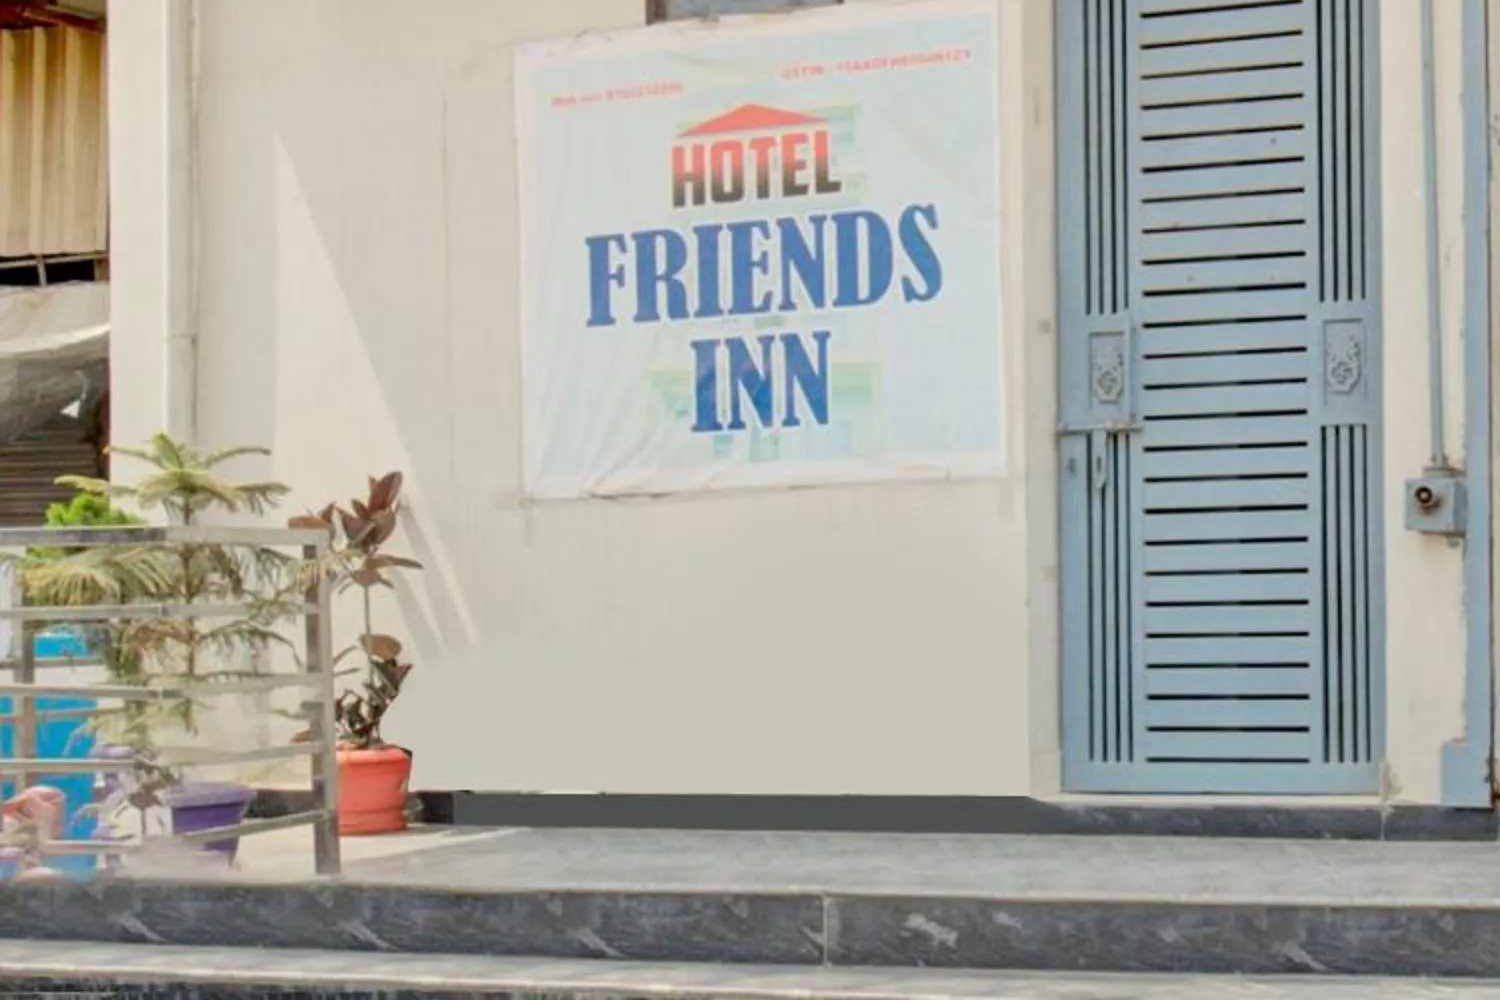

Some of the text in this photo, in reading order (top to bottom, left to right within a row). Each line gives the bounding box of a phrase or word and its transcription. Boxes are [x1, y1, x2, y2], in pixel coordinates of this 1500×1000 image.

[671, 130, 842, 208] HOTEL
[584, 203, 943, 327] FRIENDS
[690, 331, 831, 432] INN
